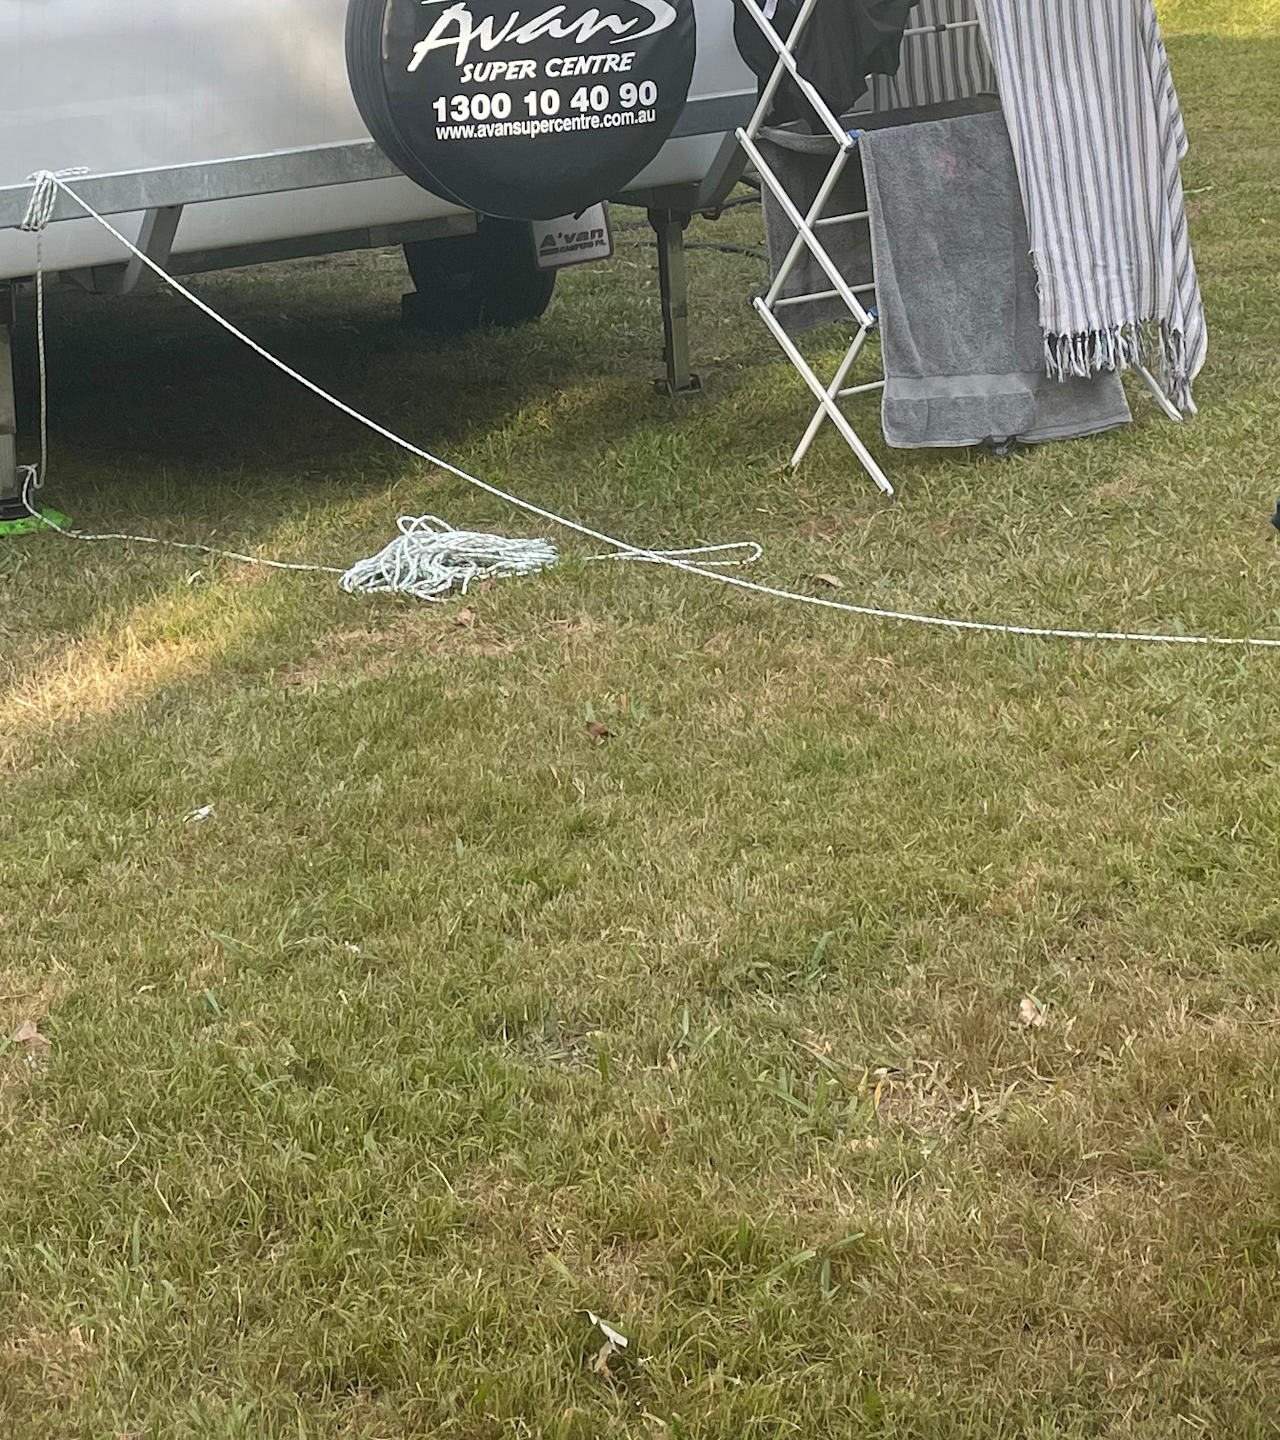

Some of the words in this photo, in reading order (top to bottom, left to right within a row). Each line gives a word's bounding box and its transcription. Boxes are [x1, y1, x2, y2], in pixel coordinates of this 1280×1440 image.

[406, 1, 640, 72] Avan
[460, 60, 537, 84] SUPER
[545, 51, 636, 78] CENTRE
[432, 93, 511, 123] 1300
[523, 90, 561, 117] 10
[570, 85, 610, 113] 40
[620, 80, 658, 107] 90
[436, 108, 656, 140] www.avansupercentre.com.au
